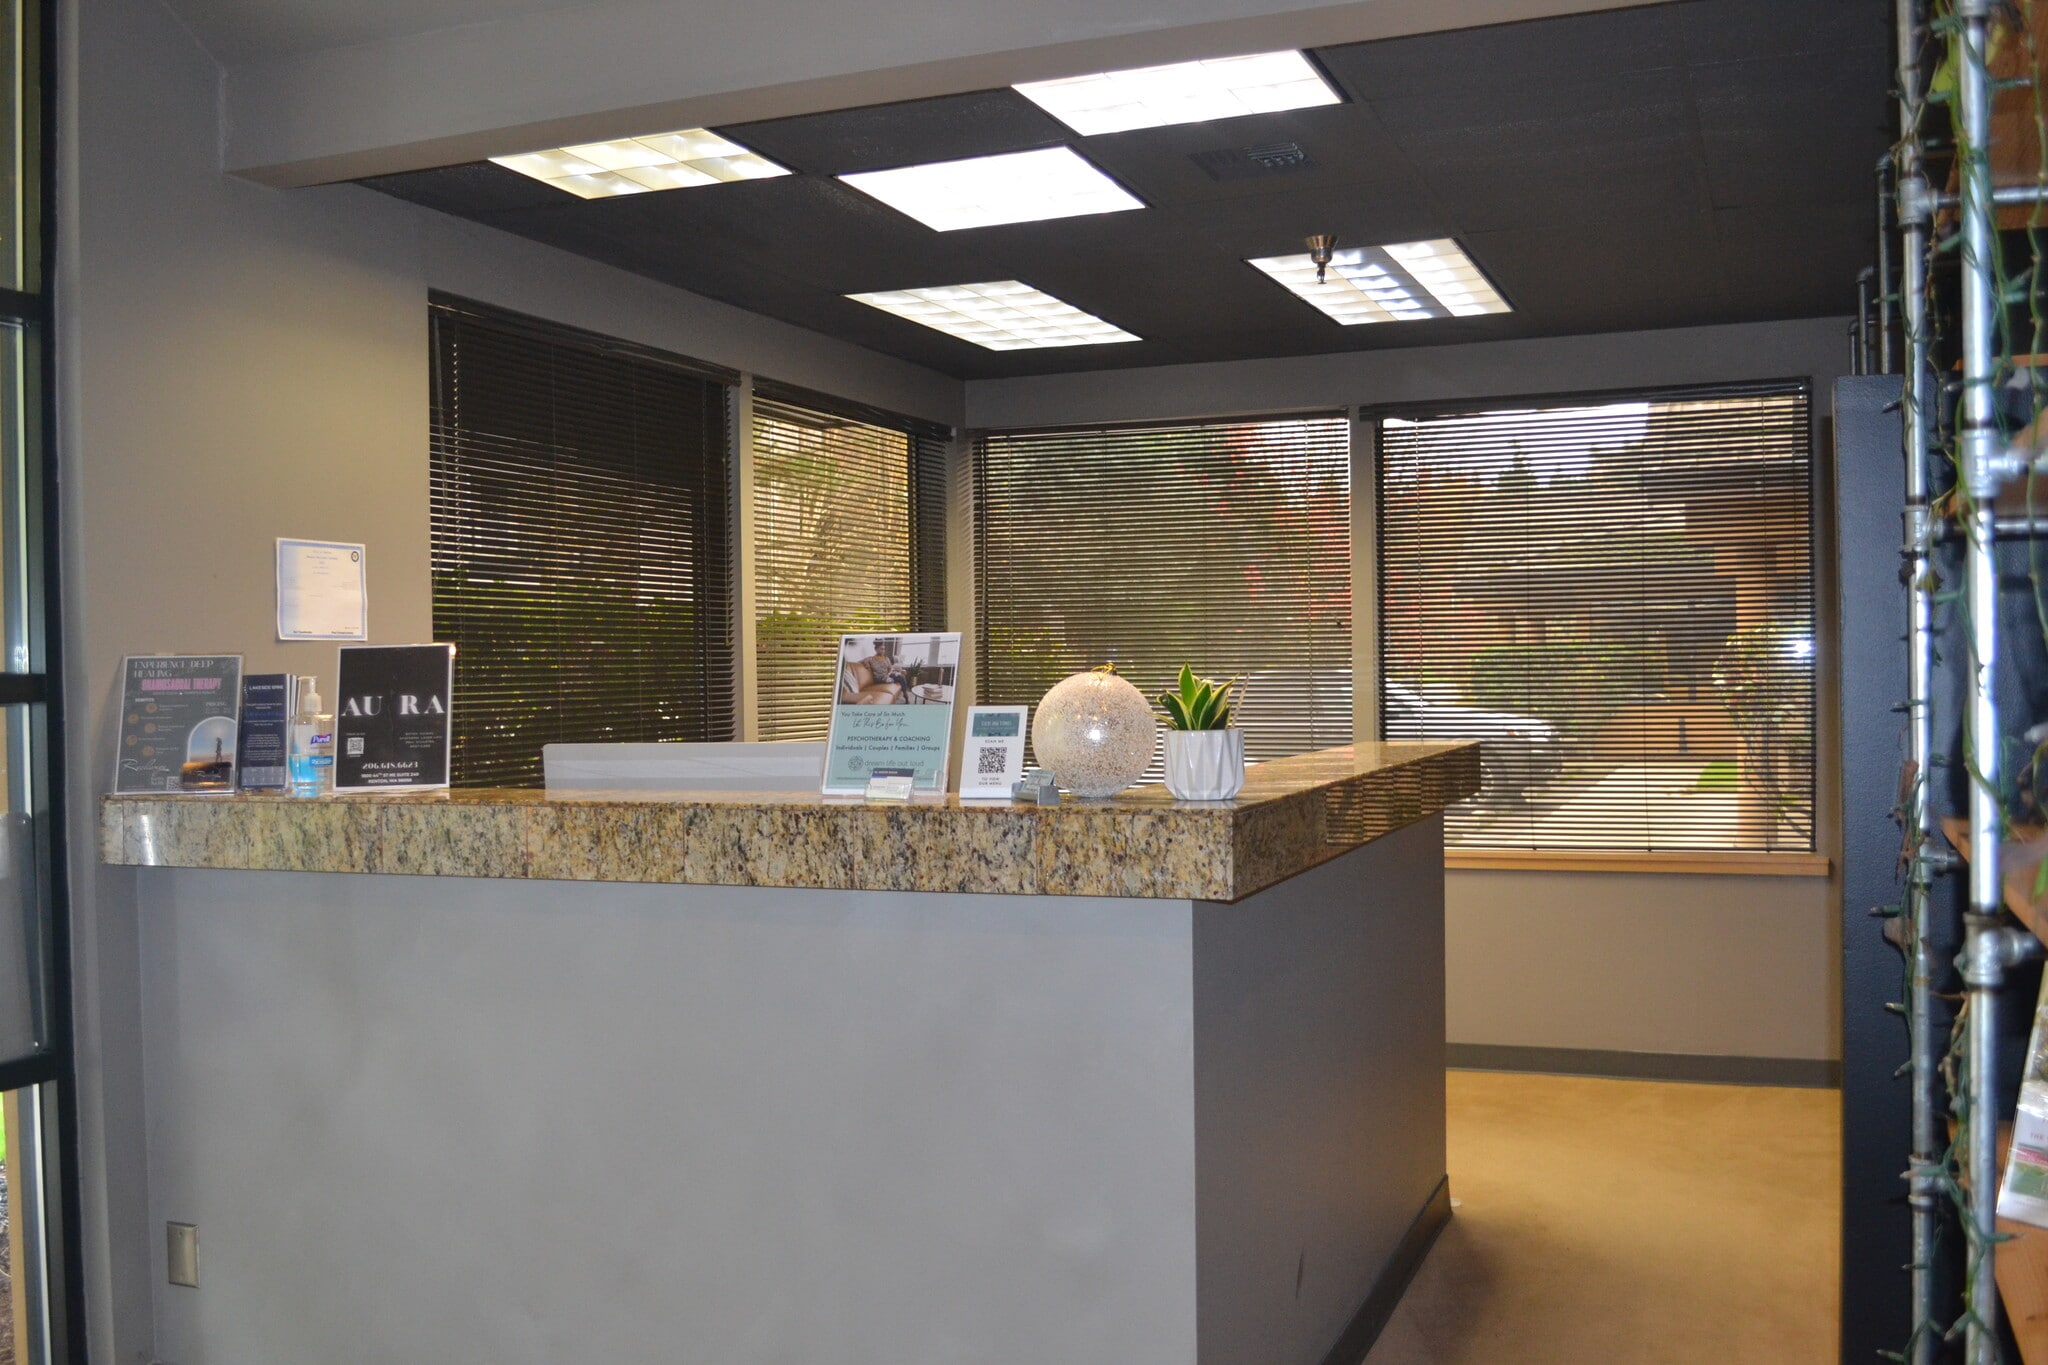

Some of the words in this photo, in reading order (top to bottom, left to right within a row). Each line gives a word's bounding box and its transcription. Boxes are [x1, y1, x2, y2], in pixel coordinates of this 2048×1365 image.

[134, 660, 185, 669] EXPERIENCE
[190, 660, 214, 668] DEEP
[134, 670, 173, 678] HEALING
[192, 677, 222, 690] THERAPY
